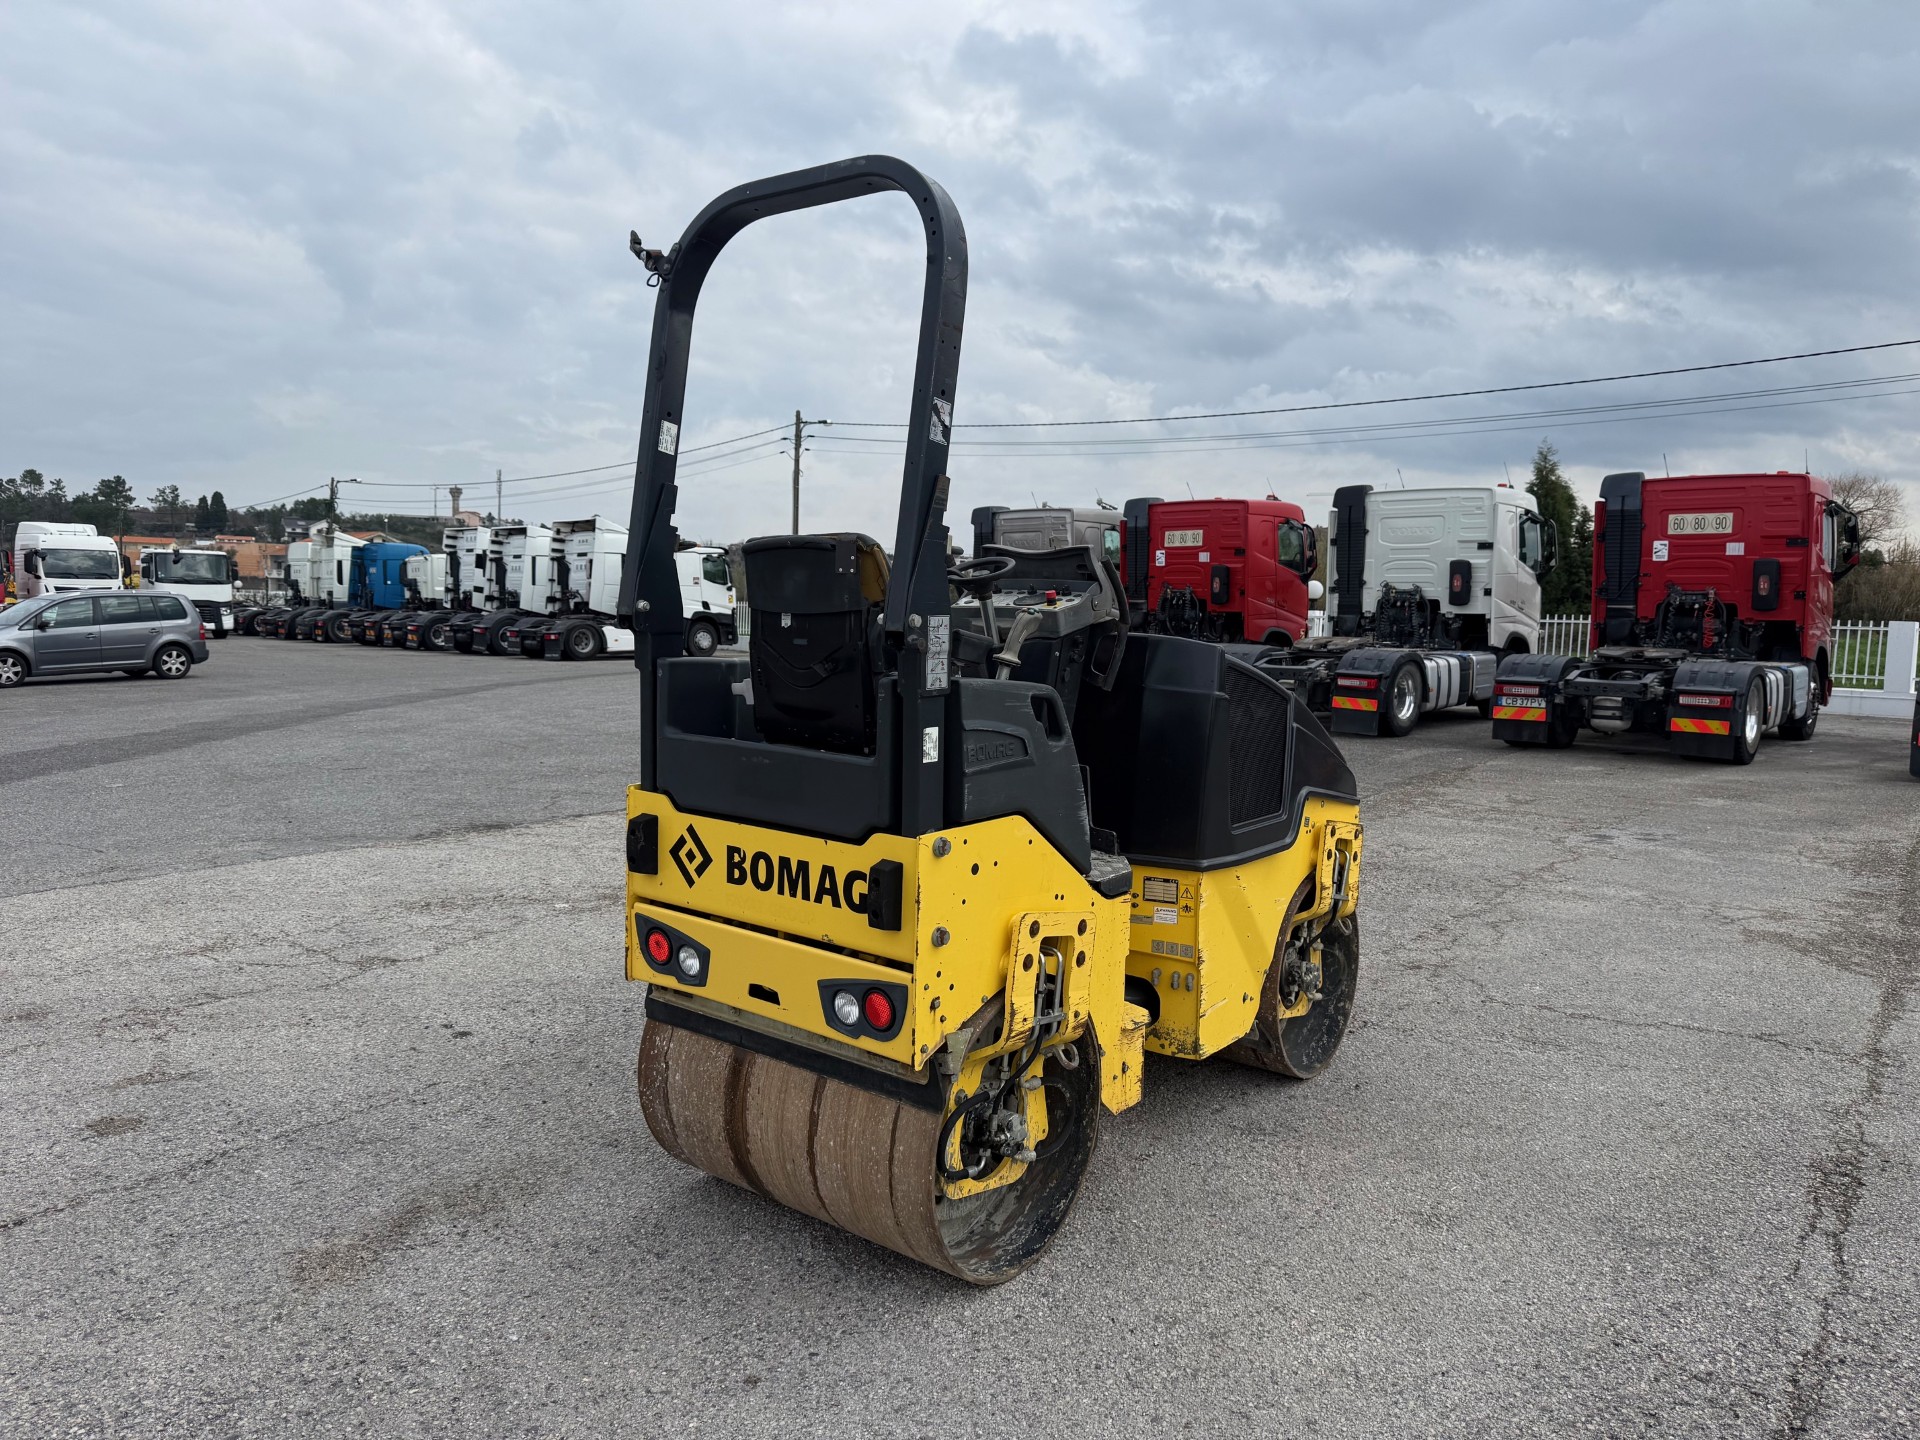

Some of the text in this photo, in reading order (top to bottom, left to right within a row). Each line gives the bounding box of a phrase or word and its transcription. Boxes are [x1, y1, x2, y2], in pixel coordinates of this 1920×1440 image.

[1673, 516, 1727, 531] 60 80 90
[1387, 526, 1436, 536] VOLVO
[1167, 532, 1200, 544] 60 80 90
[726, 845, 869, 914] BOMAG
